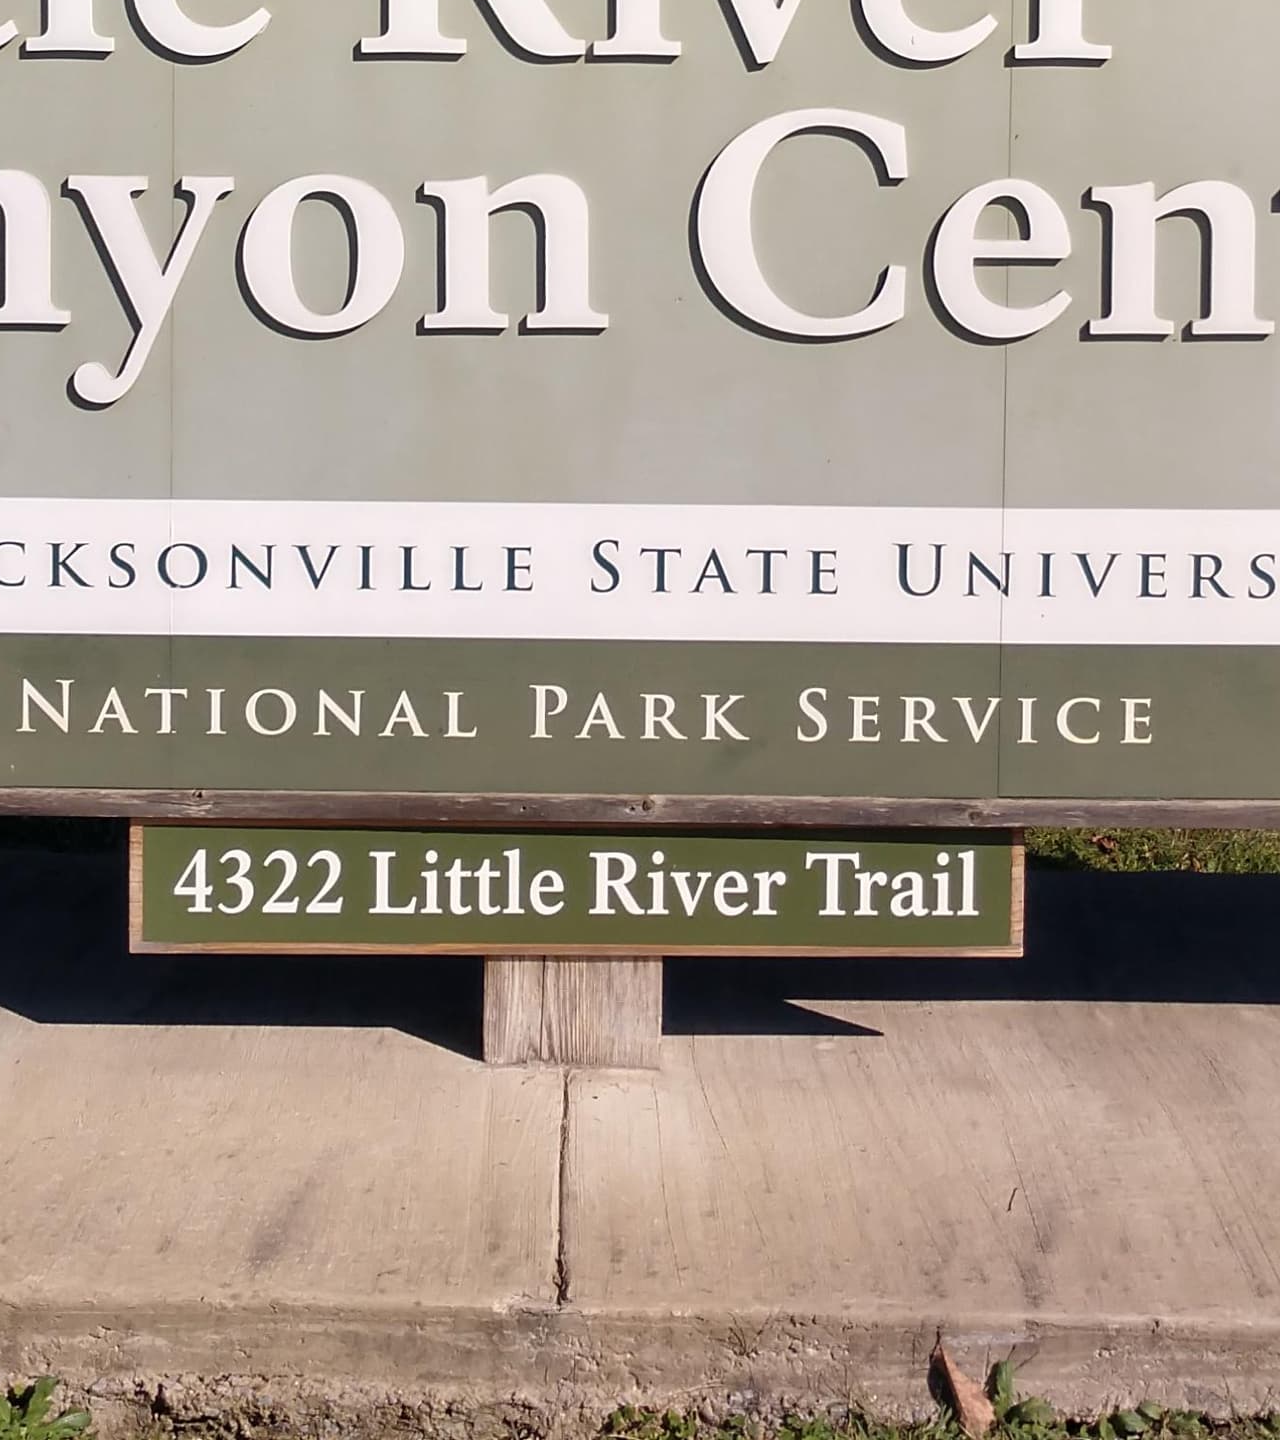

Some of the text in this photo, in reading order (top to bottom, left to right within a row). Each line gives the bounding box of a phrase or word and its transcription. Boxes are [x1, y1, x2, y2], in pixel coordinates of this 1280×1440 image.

[590, 538, 840, 596] STATE
[16, 677, 1156, 746] NATIONAL PARK SERVICE
[173, 847, 979, 919] 4322 Little River Trail
